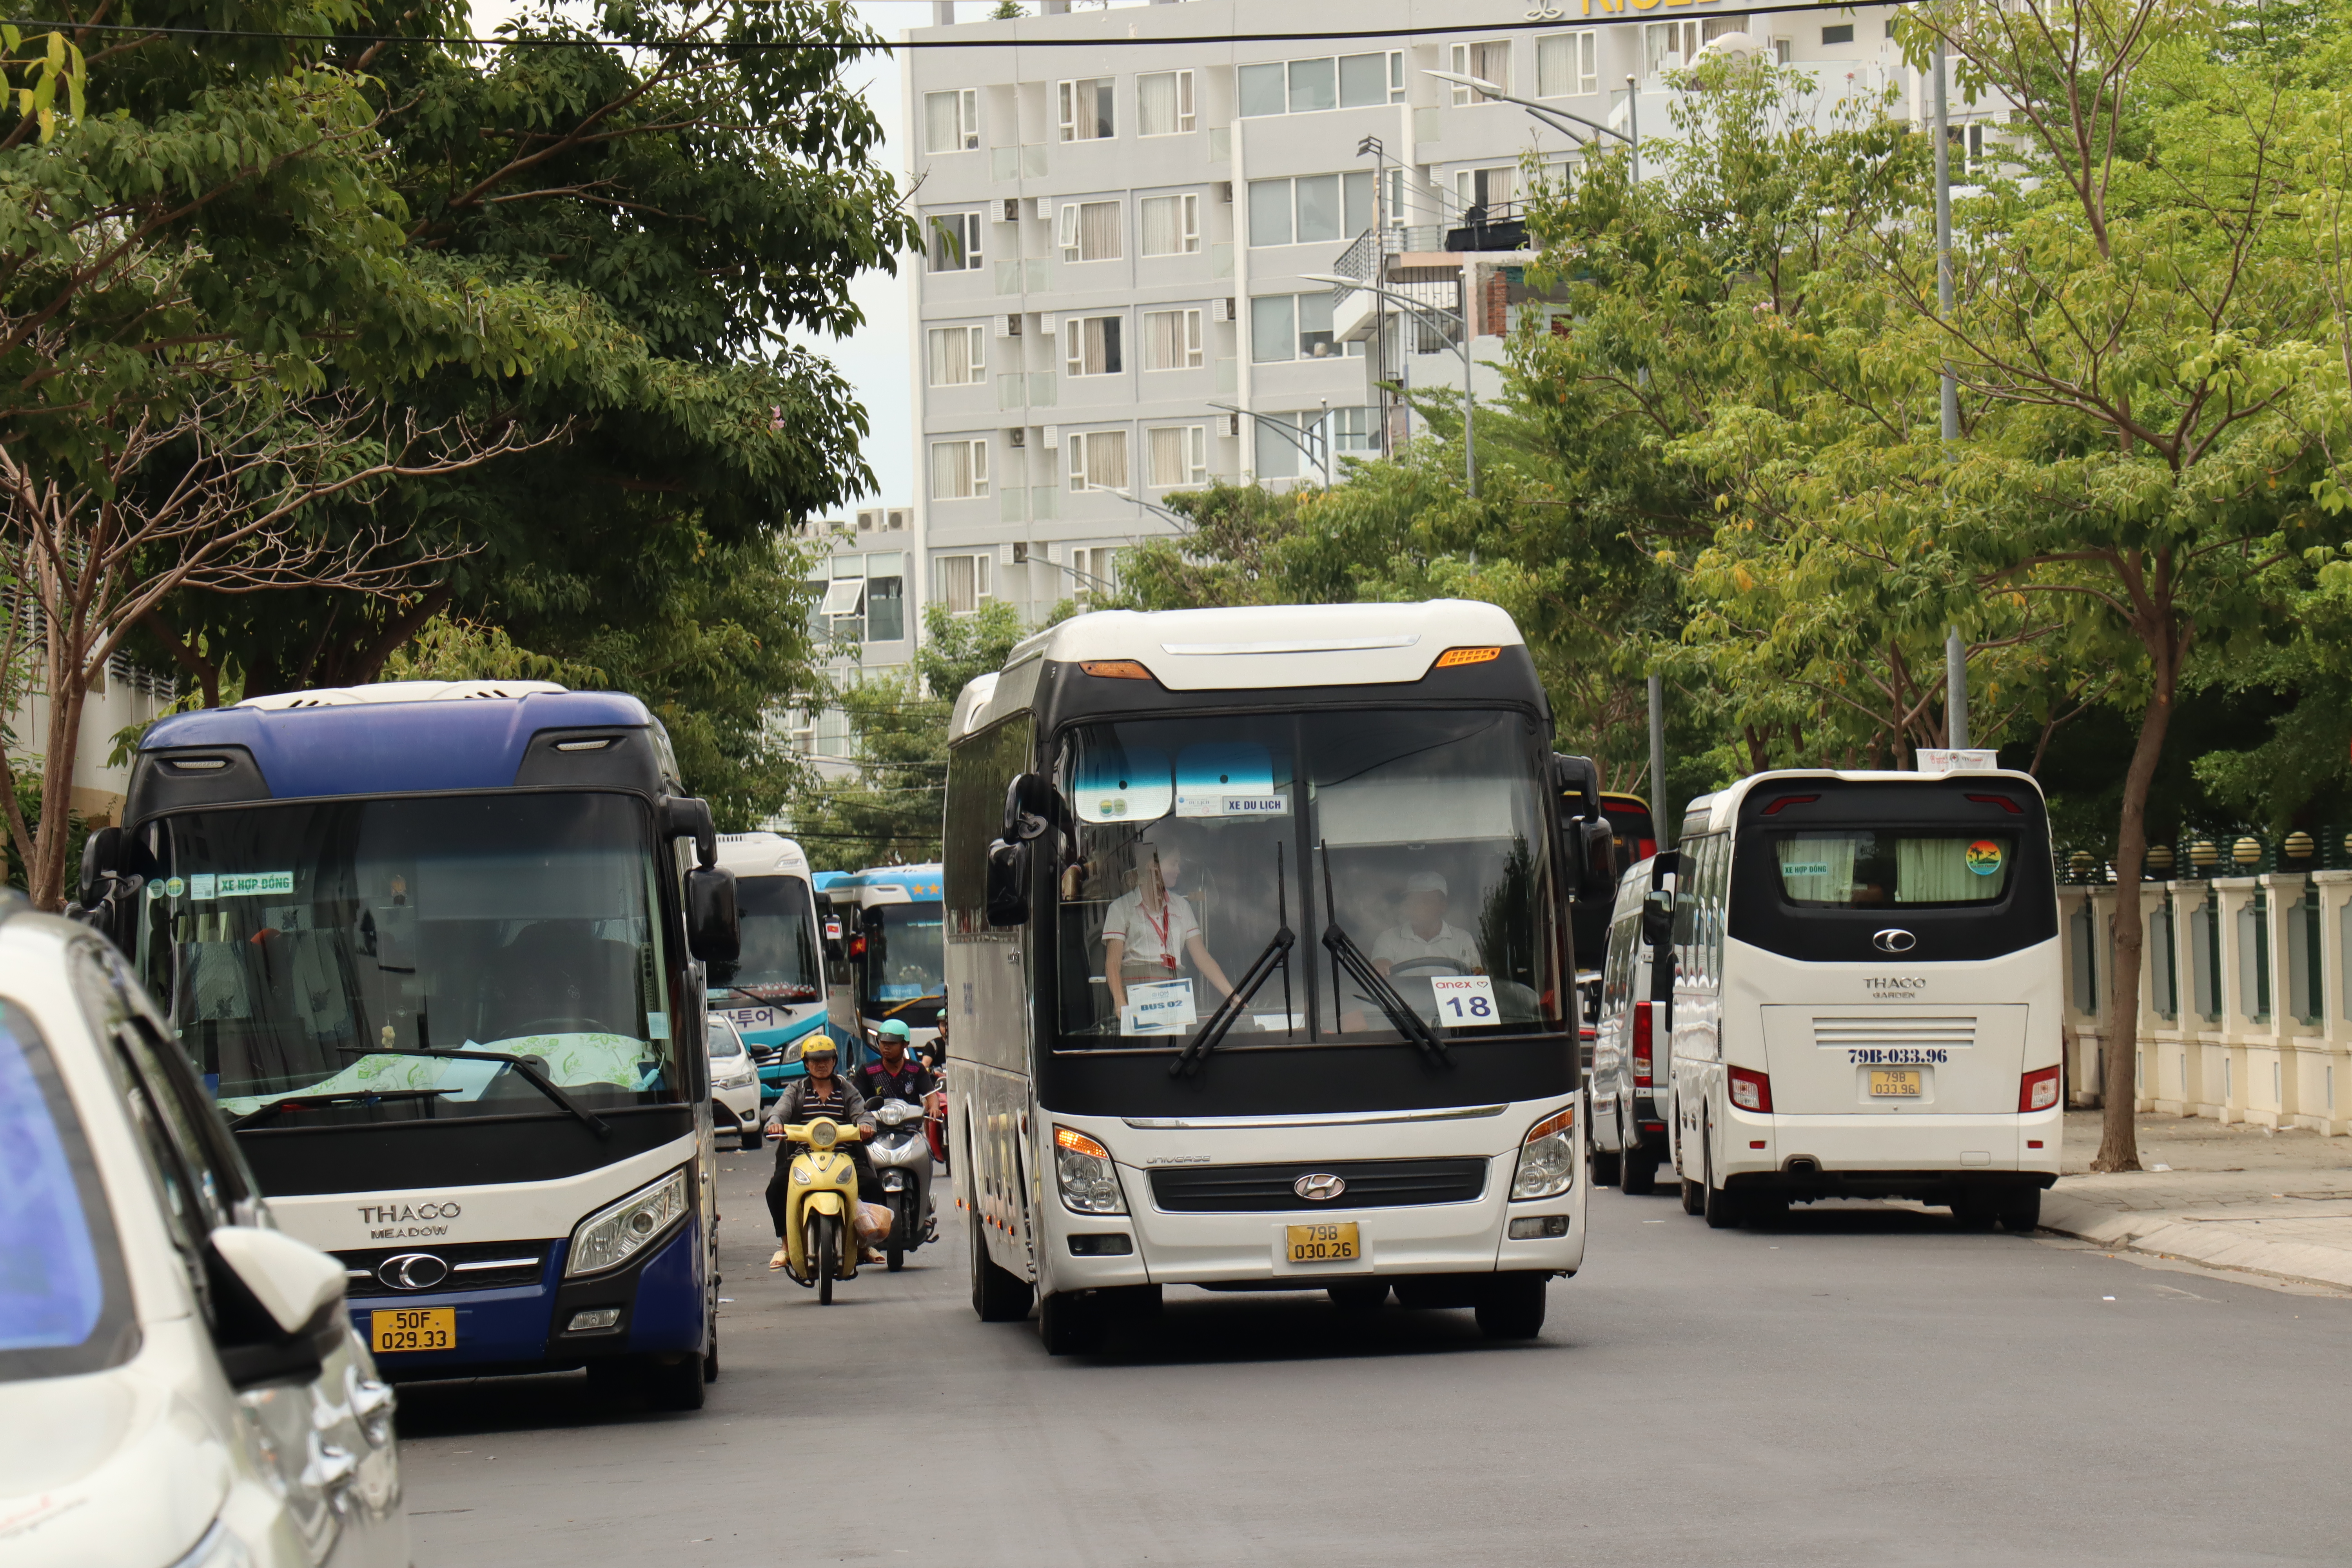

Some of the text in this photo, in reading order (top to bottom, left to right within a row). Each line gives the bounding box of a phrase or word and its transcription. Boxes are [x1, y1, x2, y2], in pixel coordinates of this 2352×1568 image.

[1229, 800, 1281, 811] XE DU LỊCH
[222, 880, 234, 891] XE
[238, 878, 258, 893] HỢP
[1863, 977, 1926, 988] THACO
[1141, 1002, 1165, 1011] BUS
[1446, 996, 1491, 1017] 18
[1848, 1049, 1947, 1063] 79B-033.96
[1884, 1071, 1906, 1083] 79B
[1876, 1084, 1916, 1094] 033.96
[1146, 1155, 1211, 1163] UNIVERSE
[358, 1201, 461, 1223] THACO
[371, 1225, 448, 1239] MEADOW
[1307, 1225, 1338, 1241] 79B
[1295, 1242, 1351, 1259] 030.26
[396, 1311, 431, 1329] 50F
[382, 1330, 446, 1349] 029.33
